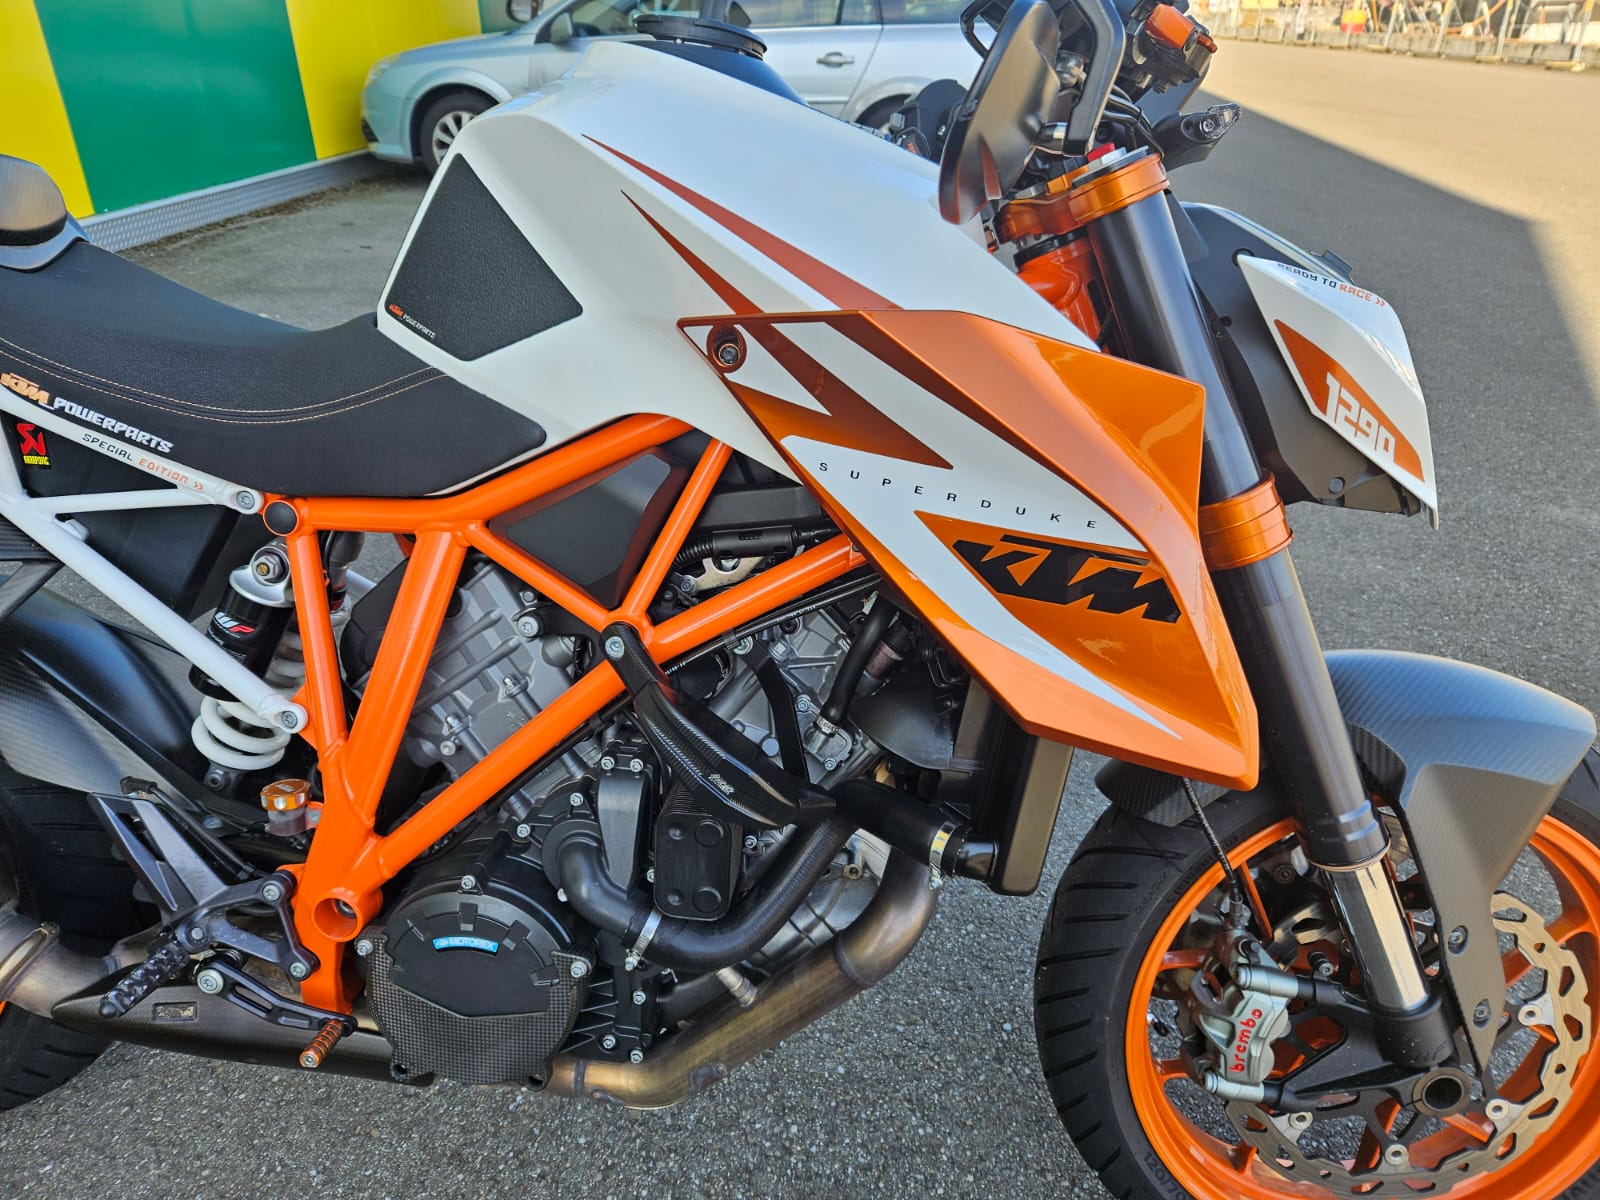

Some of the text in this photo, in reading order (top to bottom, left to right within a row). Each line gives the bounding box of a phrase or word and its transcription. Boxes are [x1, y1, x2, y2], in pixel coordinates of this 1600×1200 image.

[1277, 263, 1373, 302] READY TO RACE
[0, 372, 175, 454] KTM POWERPARTS
[1326, 371, 1397, 465] 1290
[82, 433, 189, 485] SPECIAL EDITION
[819, 461, 1097, 530] SUPERDUKE
[952, 534, 1181, 624] KTM
[1228, 1008, 1263, 1073] brembo
